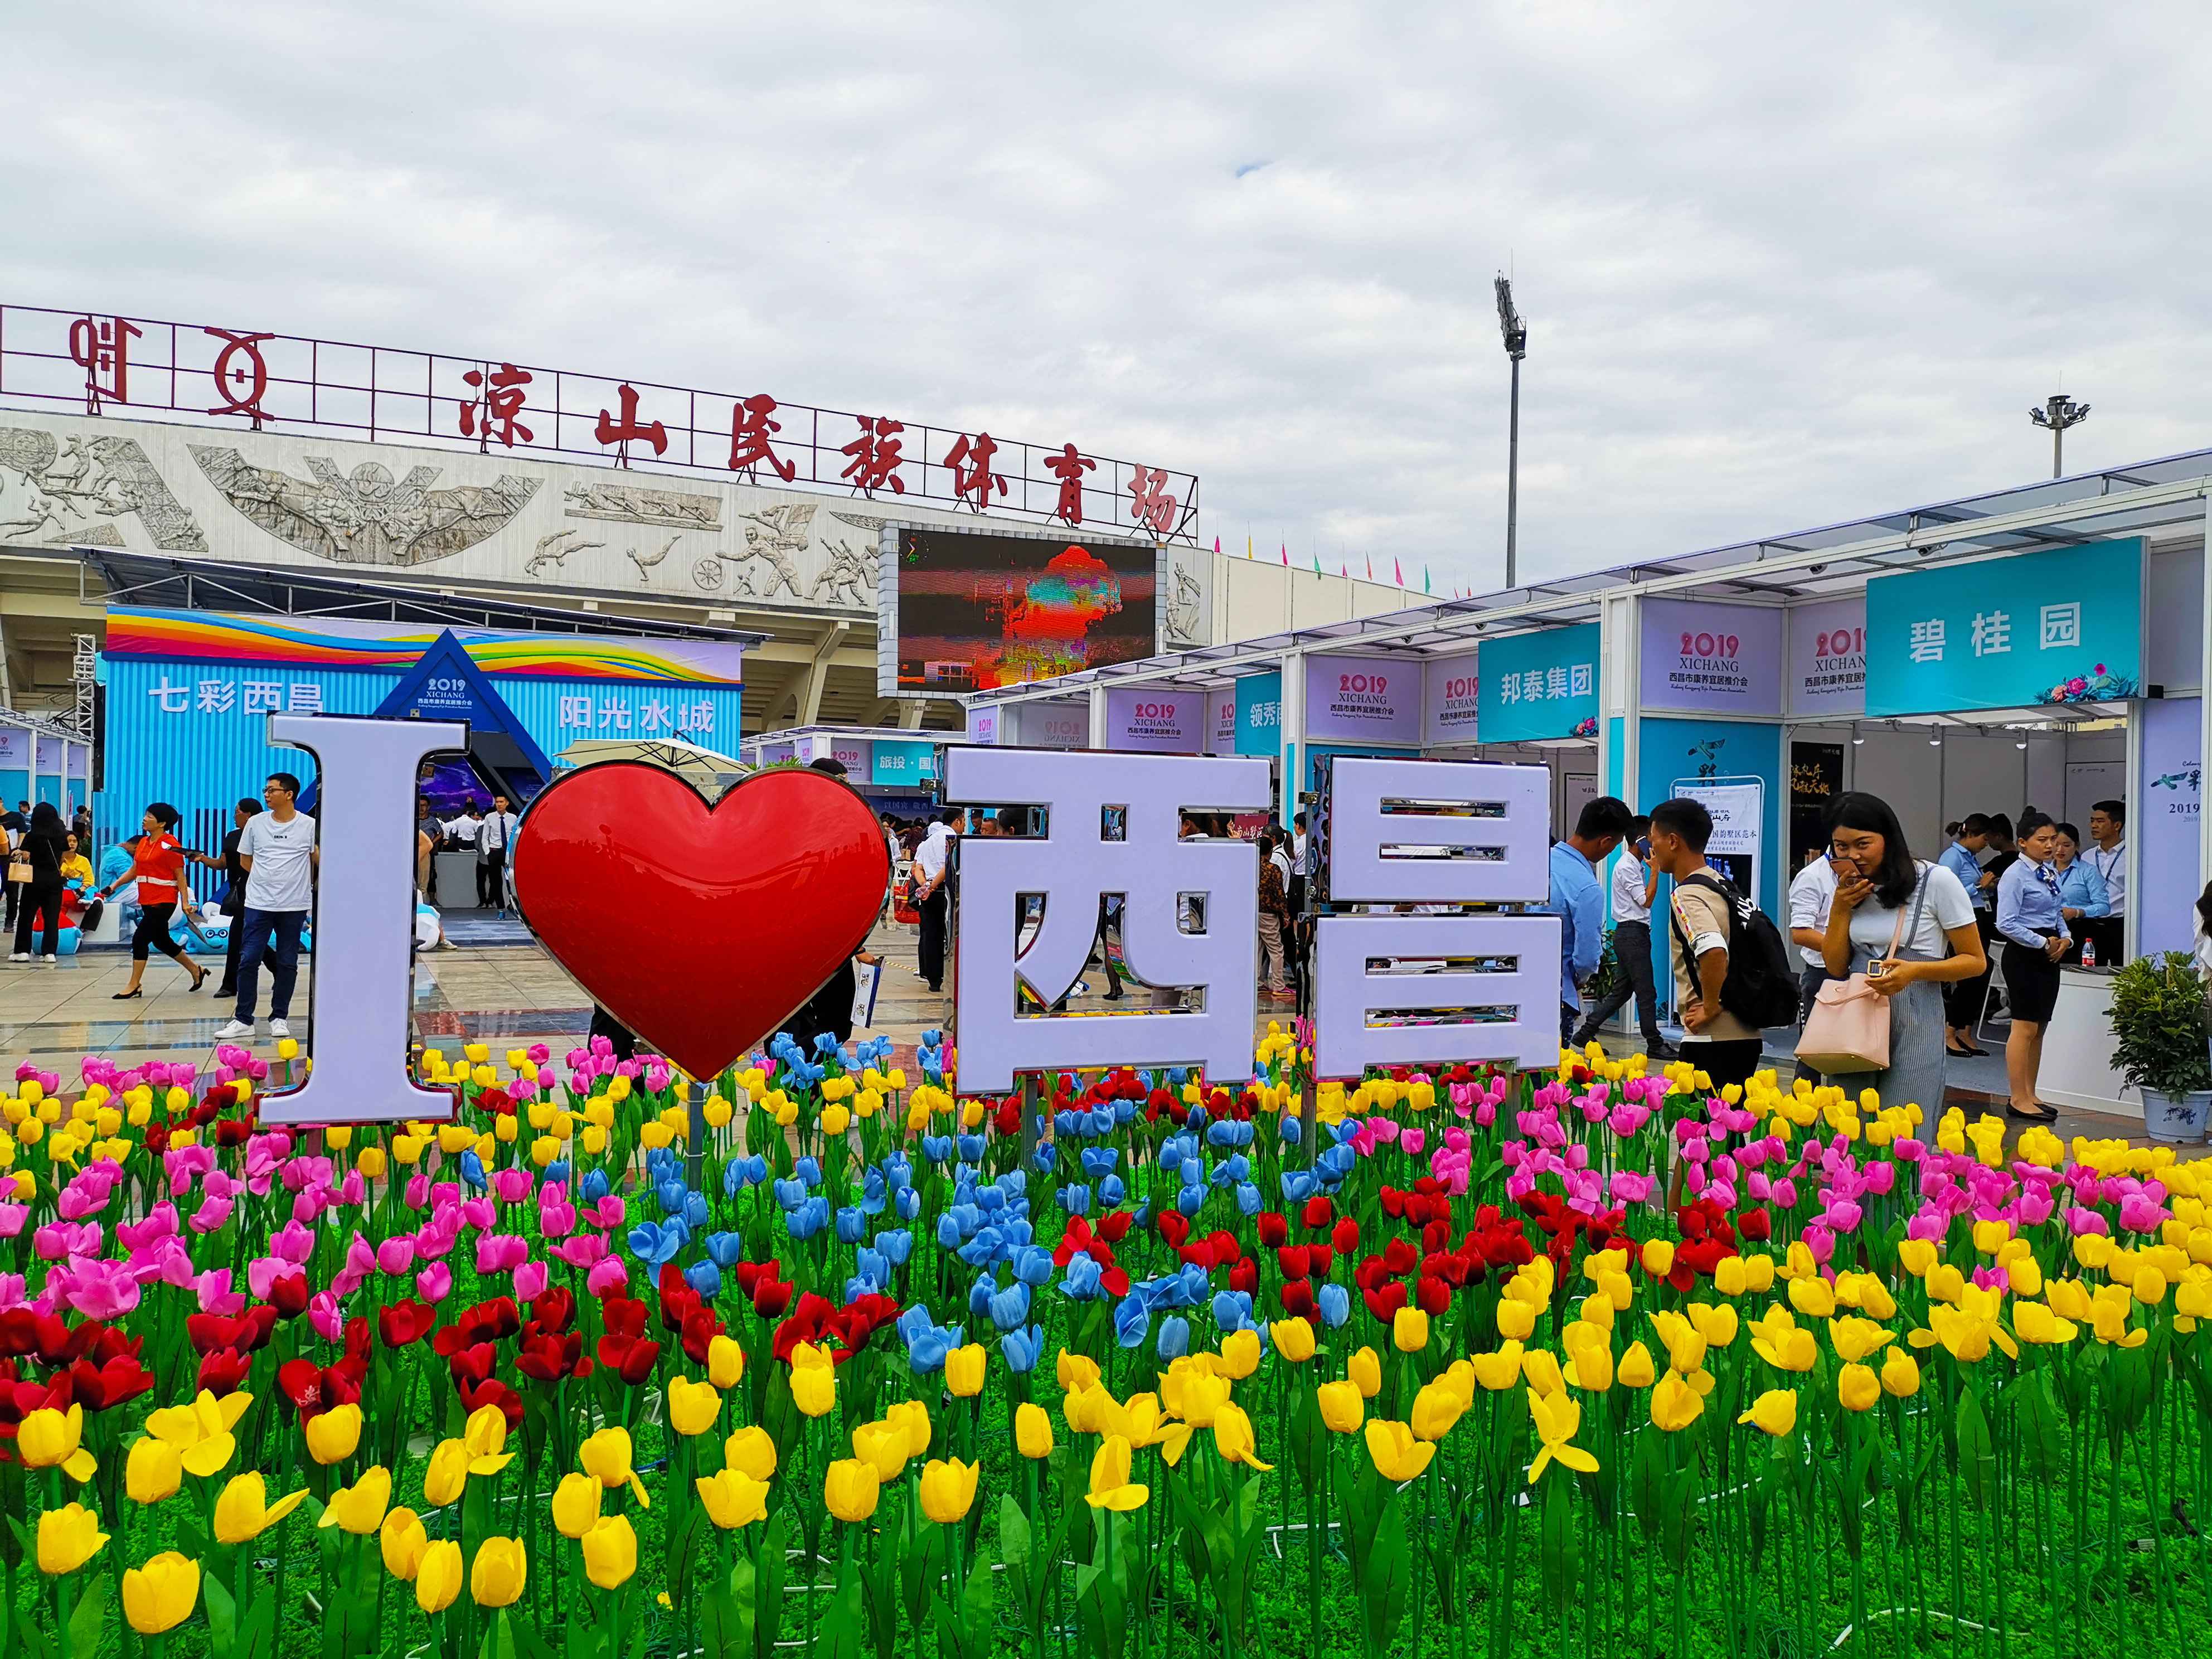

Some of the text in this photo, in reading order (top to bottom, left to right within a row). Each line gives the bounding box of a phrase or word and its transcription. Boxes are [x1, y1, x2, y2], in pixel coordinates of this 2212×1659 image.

[1909, 601, 2080, 663] 碧桂园
[1680, 632, 1739, 658] 2019
[1816, 628, 1866, 657] 201
[1679, 658, 1739, 672] XICHANG
[428, 678, 466, 691] 2019
[1339, 674, 1387, 693] 2019
[1501, 663, 1593, 705] 邦泰集团
[1669, 672, 1749, 686] 西昌市康养宜居推介会
[148, 676, 324, 715] 七彩西昌
[1338, 693, 1387, 705] XICHANG
[559, 695, 714, 733] 阳光水城
[1135, 703, 1176, 719] 2019
[1134, 719, 1176, 727] XICHANG
[832, 751, 858, 760] 2019
[2169, 803, 2200, 813] 2019
[1710, 813, 1731, 822] 山府
[259, 715, 1562, 1124] I 西昌
